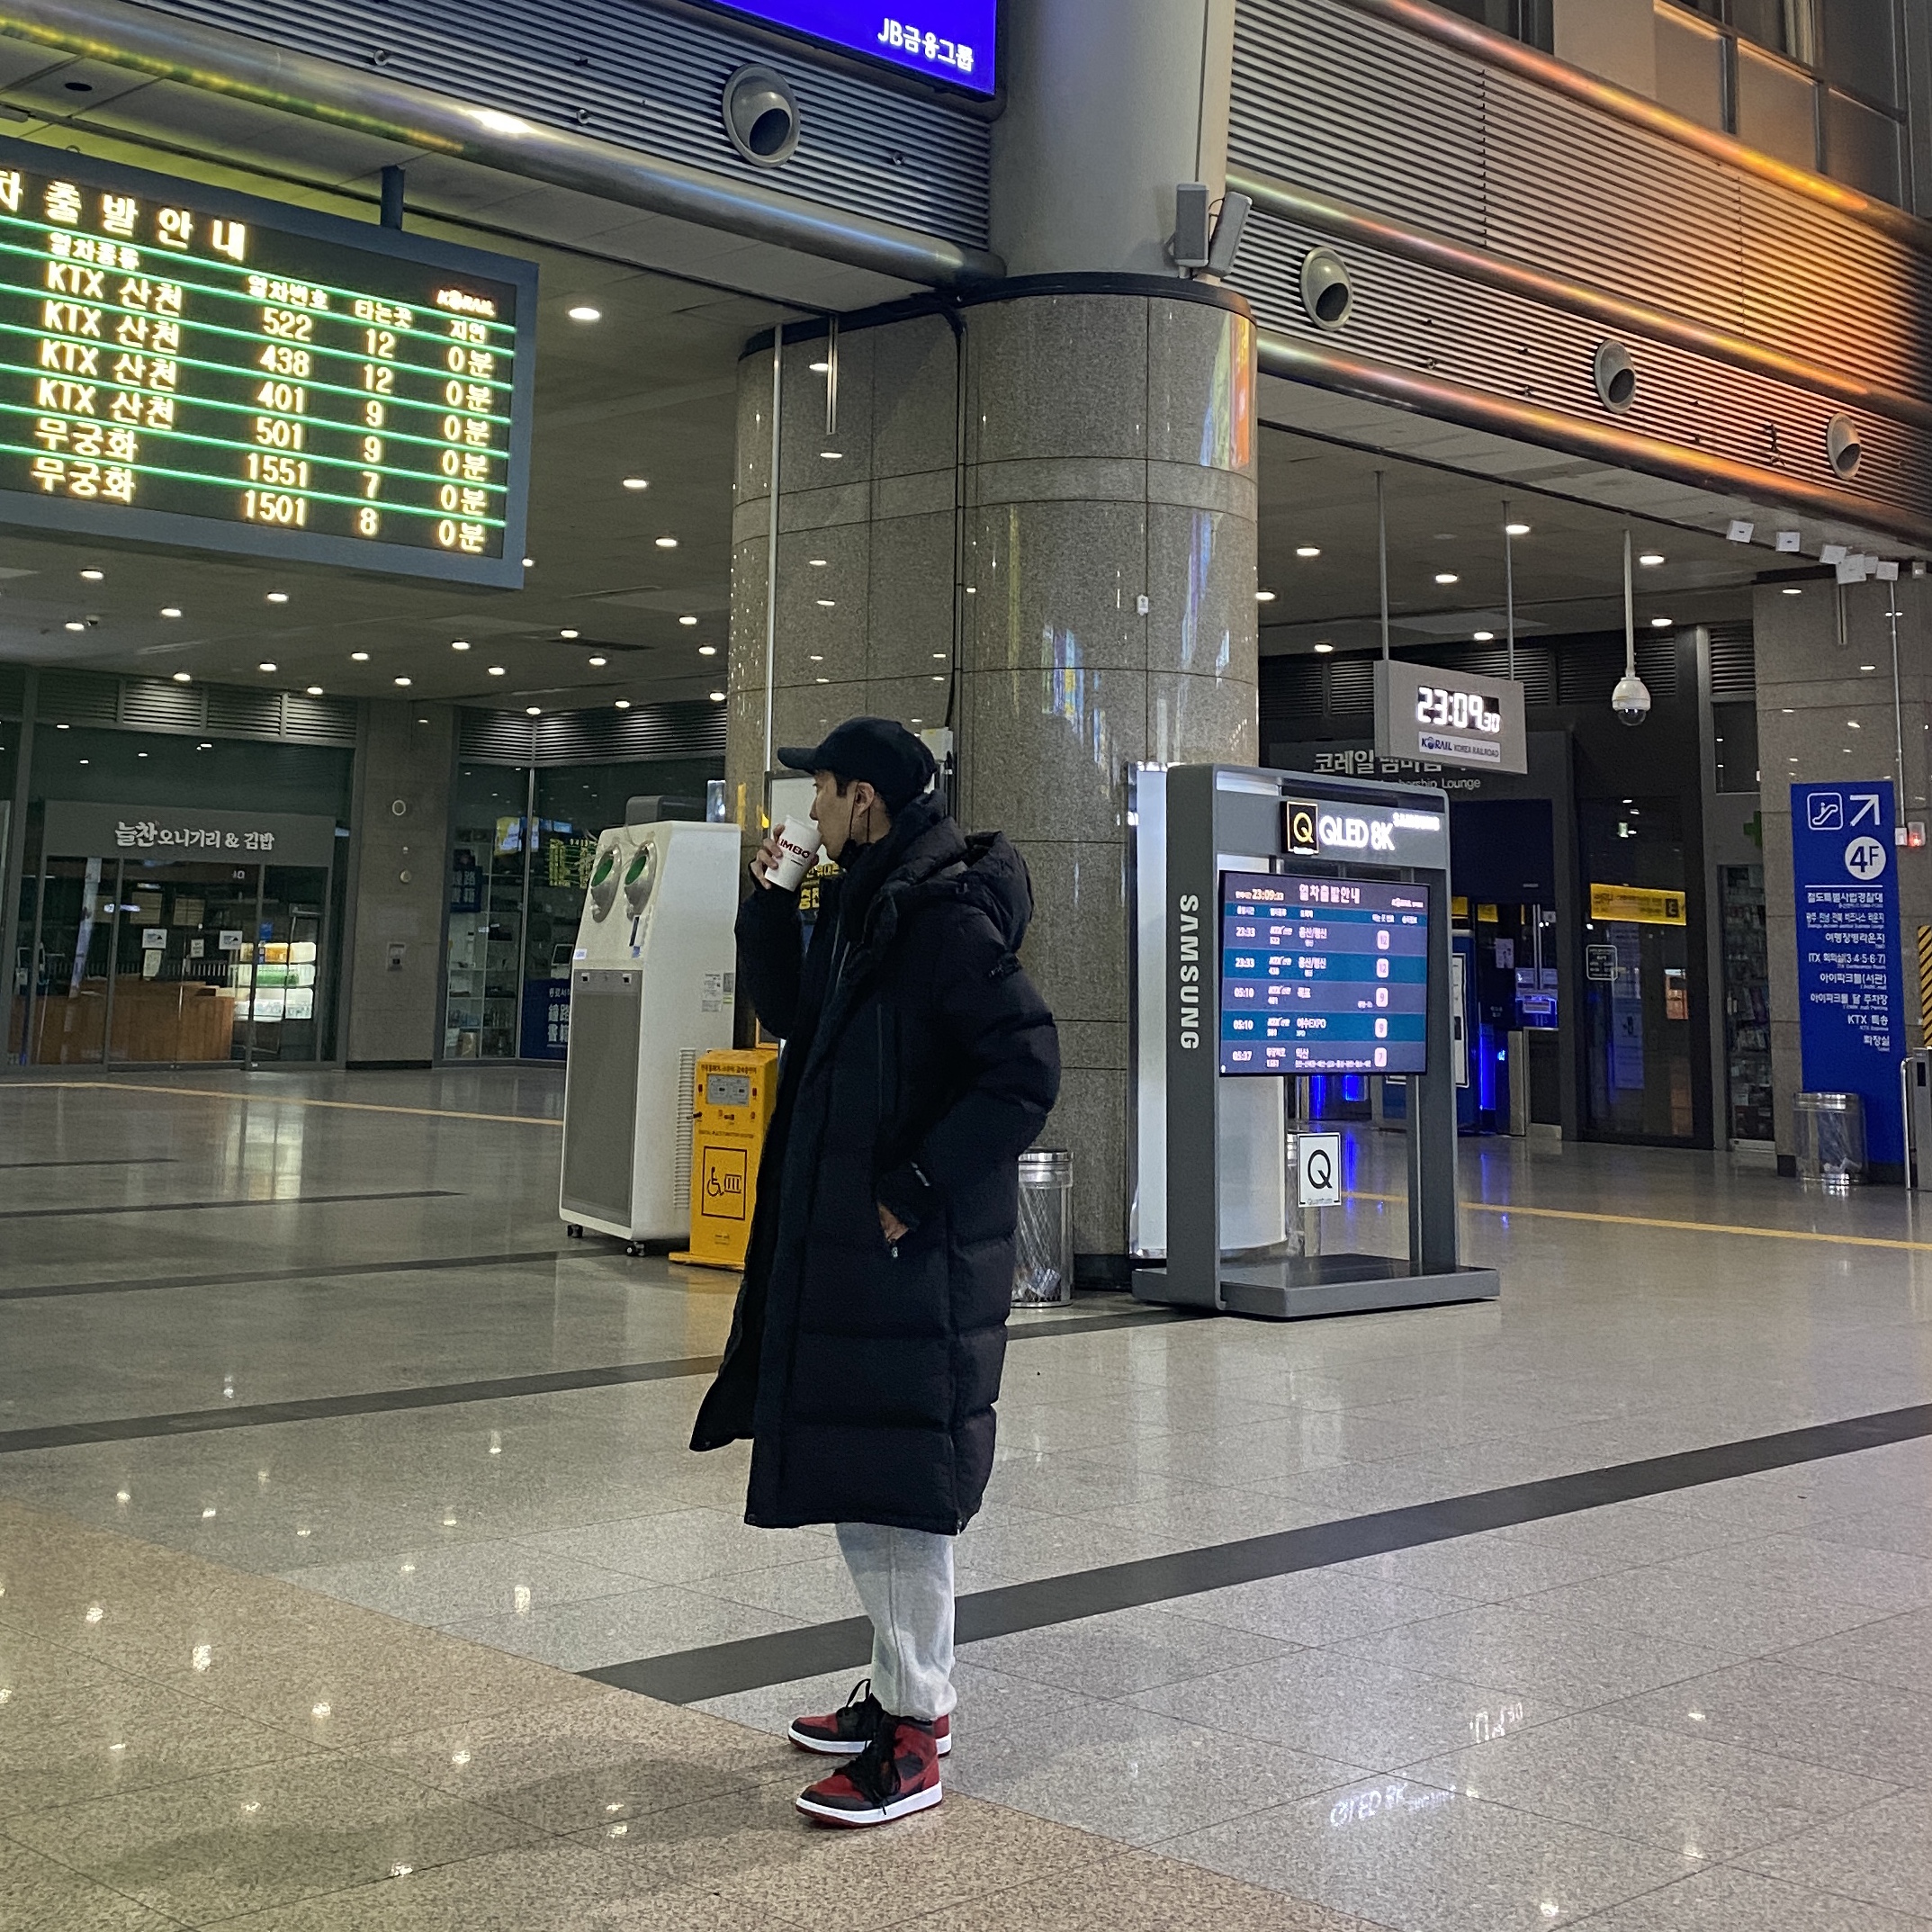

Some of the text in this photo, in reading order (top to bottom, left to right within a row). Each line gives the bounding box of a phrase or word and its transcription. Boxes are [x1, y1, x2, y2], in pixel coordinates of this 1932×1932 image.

[877, 17, 975, 72] JB금융그룹
[44, 181, 83, 225] 출
[102, 191, 139, 238] 발
[157, 203, 193, 249] 안
[211, 216, 247, 262] 내
[48, 230, 140, 270] 열차종류
[47, 261, 104, 301] KTX
[118, 278, 183, 319] 산천
[263, 305, 313, 342] 522
[364, 328, 397, 360] 12
[247, 274, 487, 344] 열차번호 타는곳 지연
[43, 299, 102, 338] KTX
[115, 315, 180, 356] 산천
[259, 344, 310, 378] 438
[363, 363, 394, 394] 12
[40, 338, 99, 377] KTX
[112, 354, 178, 393] 산천
[257, 382, 306, 416] 401
[364, 399, 384, 428] 9
[37, 378, 96, 417] KTX
[109, 391, 176, 432] 산천
[256, 417, 304, 450] 501
[362, 434, 382, 464] 9
[33, 415, 139, 464] 무궁화
[245, 453, 310, 488] 1551
[362, 470, 380, 499] 7
[31, 454, 136, 504] 무궁화
[242, 489, 308, 526] 1501
[359, 508, 379, 536] 8
[1417, 686, 1483, 730] 23:09
[1313, 750, 1375, 775] 코레일
[1421, 736, 1499, 759] KORAIL KOREA RAILROAD
[1442, 777, 1481, 791] Lounge
[115, 821, 275, 851] 늘찬 오니기리 & 김밥
[778, 838, 811, 859] IMBO
[1293, 812, 1315, 844] Q
[1318, 813, 1370, 849] QLED
[1370, 820, 1397, 851] 8K
[1849, 845, 1880, 873] 4F
[1298, 884, 1361, 903] 열차출발안내
[1180, 894, 1200, 1049] SAMSUNG
[1847, 1014, 1867, 1024] KTX
[1864, 994, 1888, 1005] 주차장
[1864, 1035, 1891, 1047] 화장실
[1307, 1149, 1333, 1190] Q
